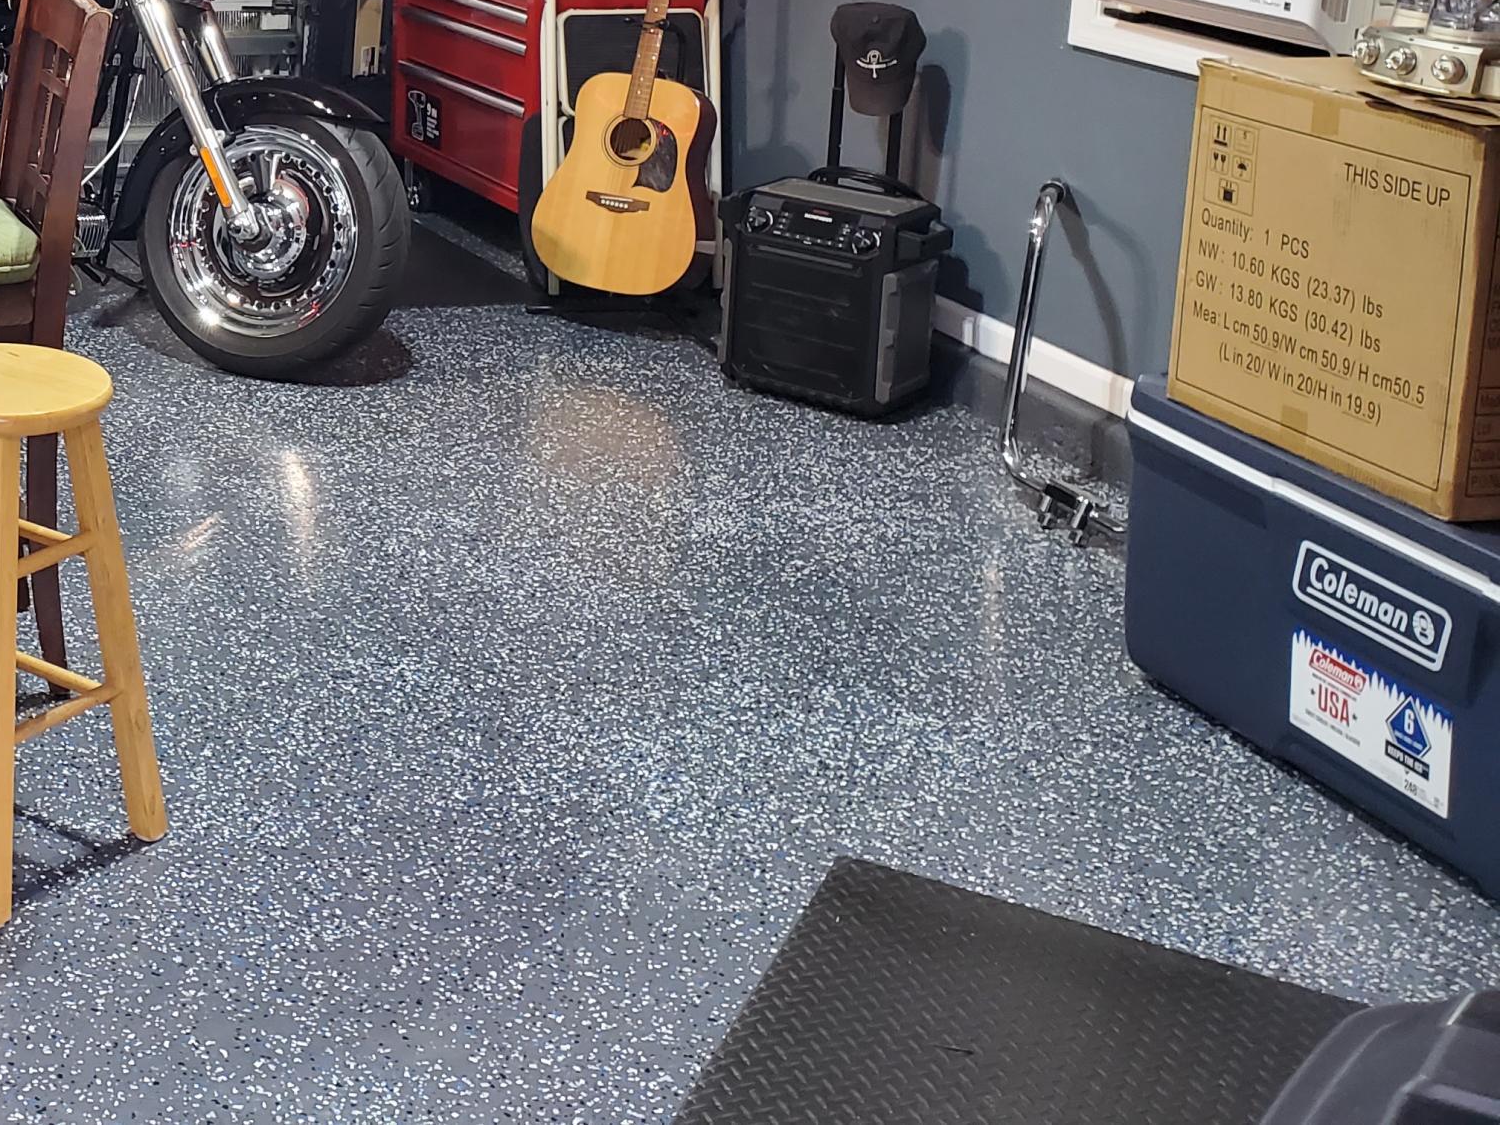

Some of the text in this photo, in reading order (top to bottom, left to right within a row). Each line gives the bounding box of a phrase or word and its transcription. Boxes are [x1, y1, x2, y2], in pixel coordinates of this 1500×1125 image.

[1344, 162, 1451, 207] THIS SIDE UP
[1201, 207, 1309, 259] Quantity: 1 PCS
[1232, 251, 1265, 278] 10.60
[1271, 263, 1300, 290] KGS
[1307, 276, 1355, 314] (23.37)
[1362, 294, 1383, 318] lbs
[1193, 299, 1220, 326] Mea:
[1232, 319, 1250, 338] cm
[1299, 345, 1318, 364] cm
[1358, 363, 1370, 384] H
[1231, 282, 1263, 309] 13.80
[1269, 295, 1298, 323] KGS
[1305, 310, 1353, 347] (30.42)
[1360, 328, 1381, 353] lbs
[1233, 347, 1243, 366] in
[1268, 360, 1281, 382] W
[1283, 366, 1294, 387] in
[1330, 386, 1342, 408] in
[1347, 393, 1381, 427] 19.9)
[1310, 557, 1408, 633] Coleman
[1313, 651, 1354, 686] Coleman
[1318, 683, 1350, 728] USA
[1404, 708, 1414, 735] 6
